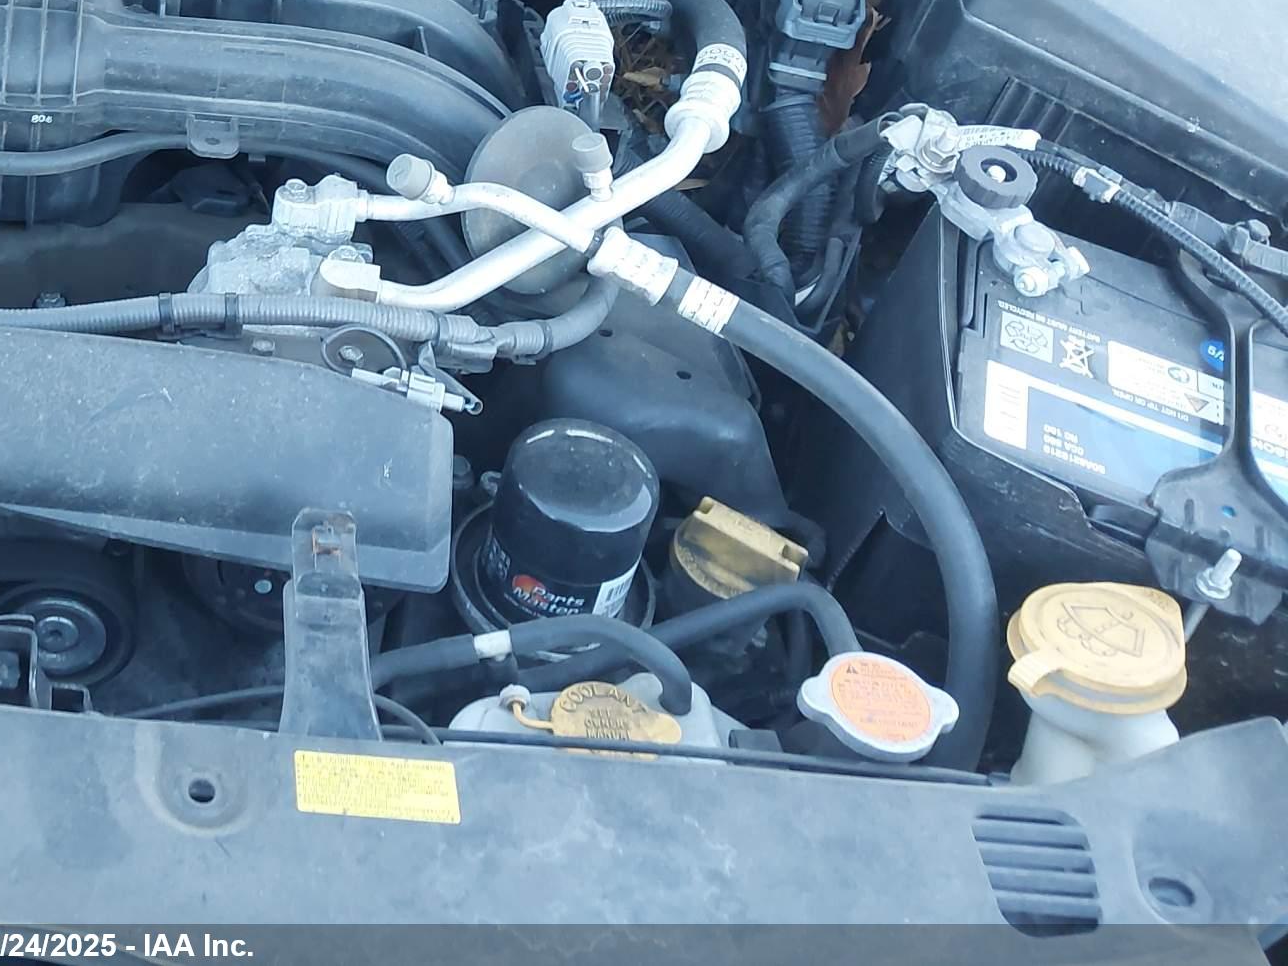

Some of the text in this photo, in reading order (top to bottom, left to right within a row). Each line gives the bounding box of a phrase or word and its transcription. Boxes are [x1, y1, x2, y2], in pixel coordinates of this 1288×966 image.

[513, 586, 582, 615] Master
[532, 586, 585, 606] Parts
[559, 684, 649, 713] COOLANT
